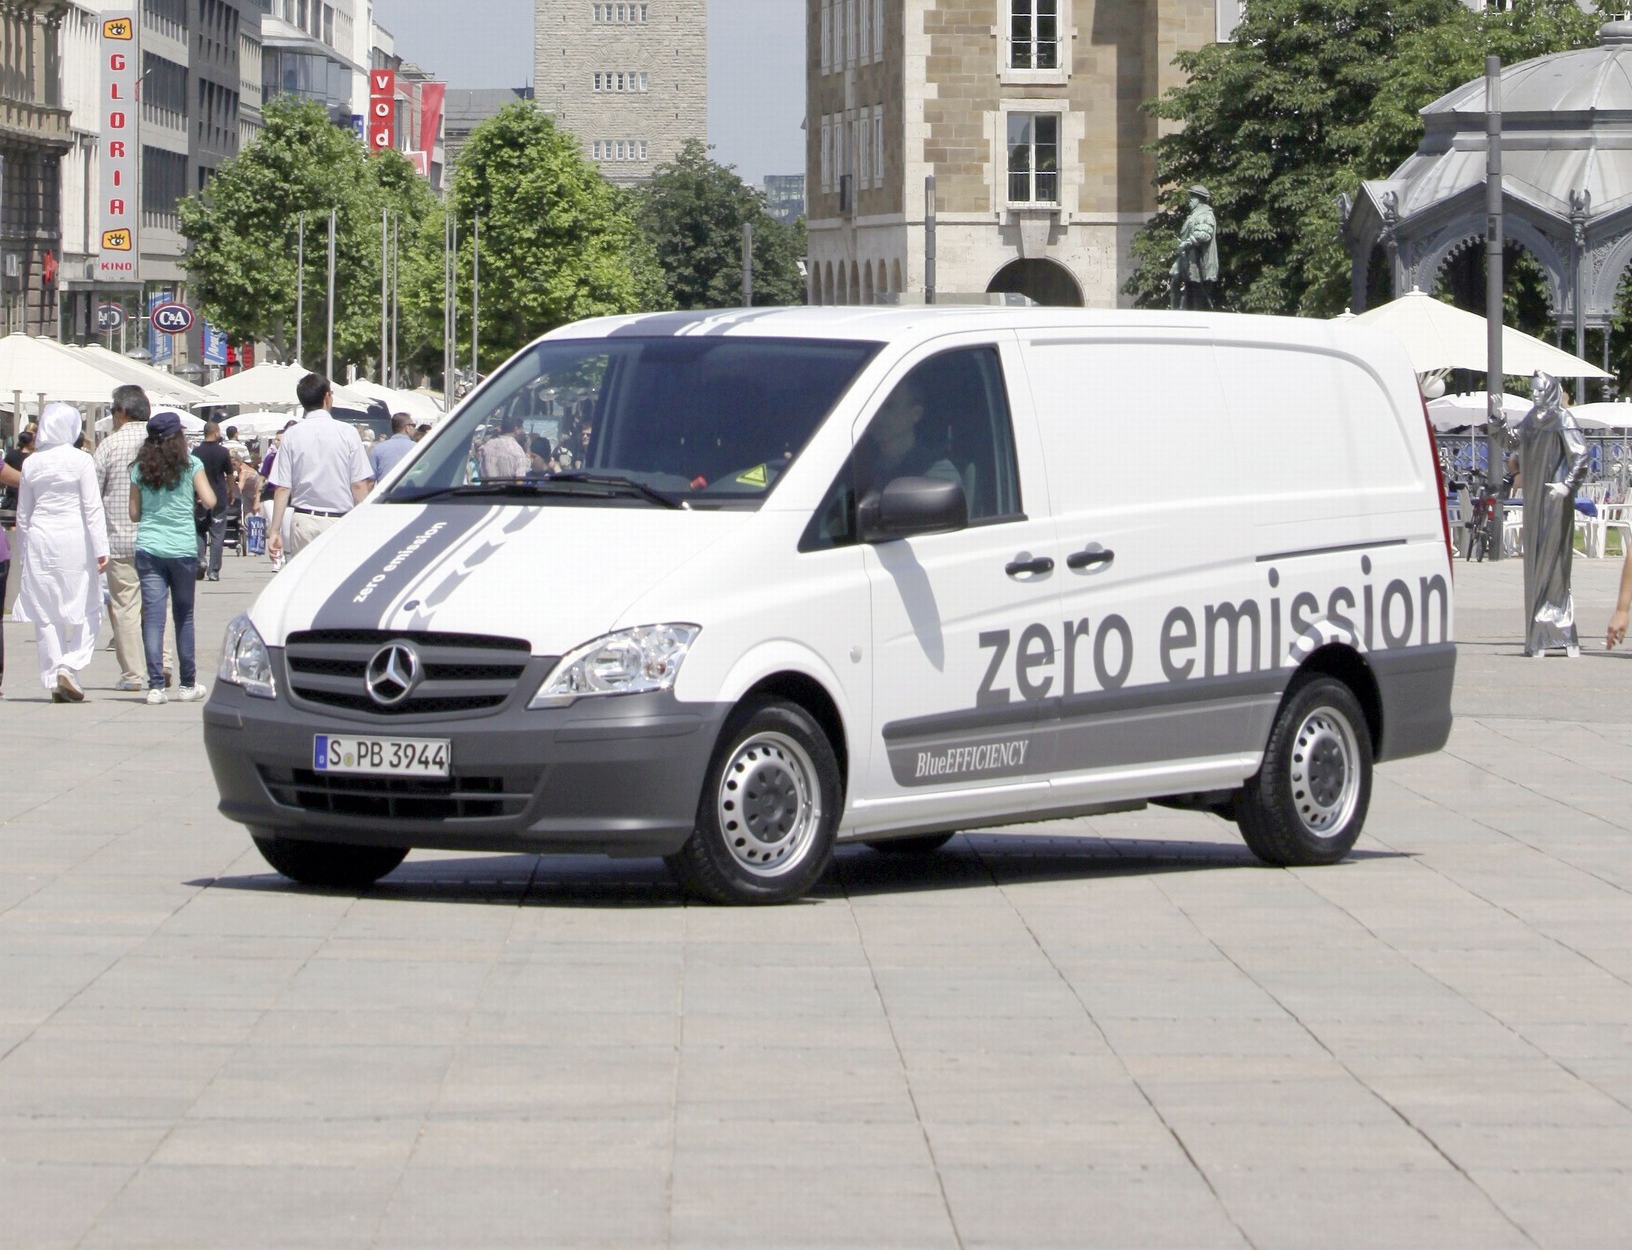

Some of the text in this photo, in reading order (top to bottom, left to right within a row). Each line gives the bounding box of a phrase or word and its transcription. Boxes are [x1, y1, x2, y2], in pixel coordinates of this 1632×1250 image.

[110, 54, 126, 216] GLORIA
[101, 262, 132, 271] KINO
[160, 311, 187, 326] C&A
[353, 522, 448, 603] zero emission
[976, 554, 1448, 710] zero emission
[329, 740, 445, 770] S PB 3944
[915, 740, 1029, 777] BlueEFFICIENCY
